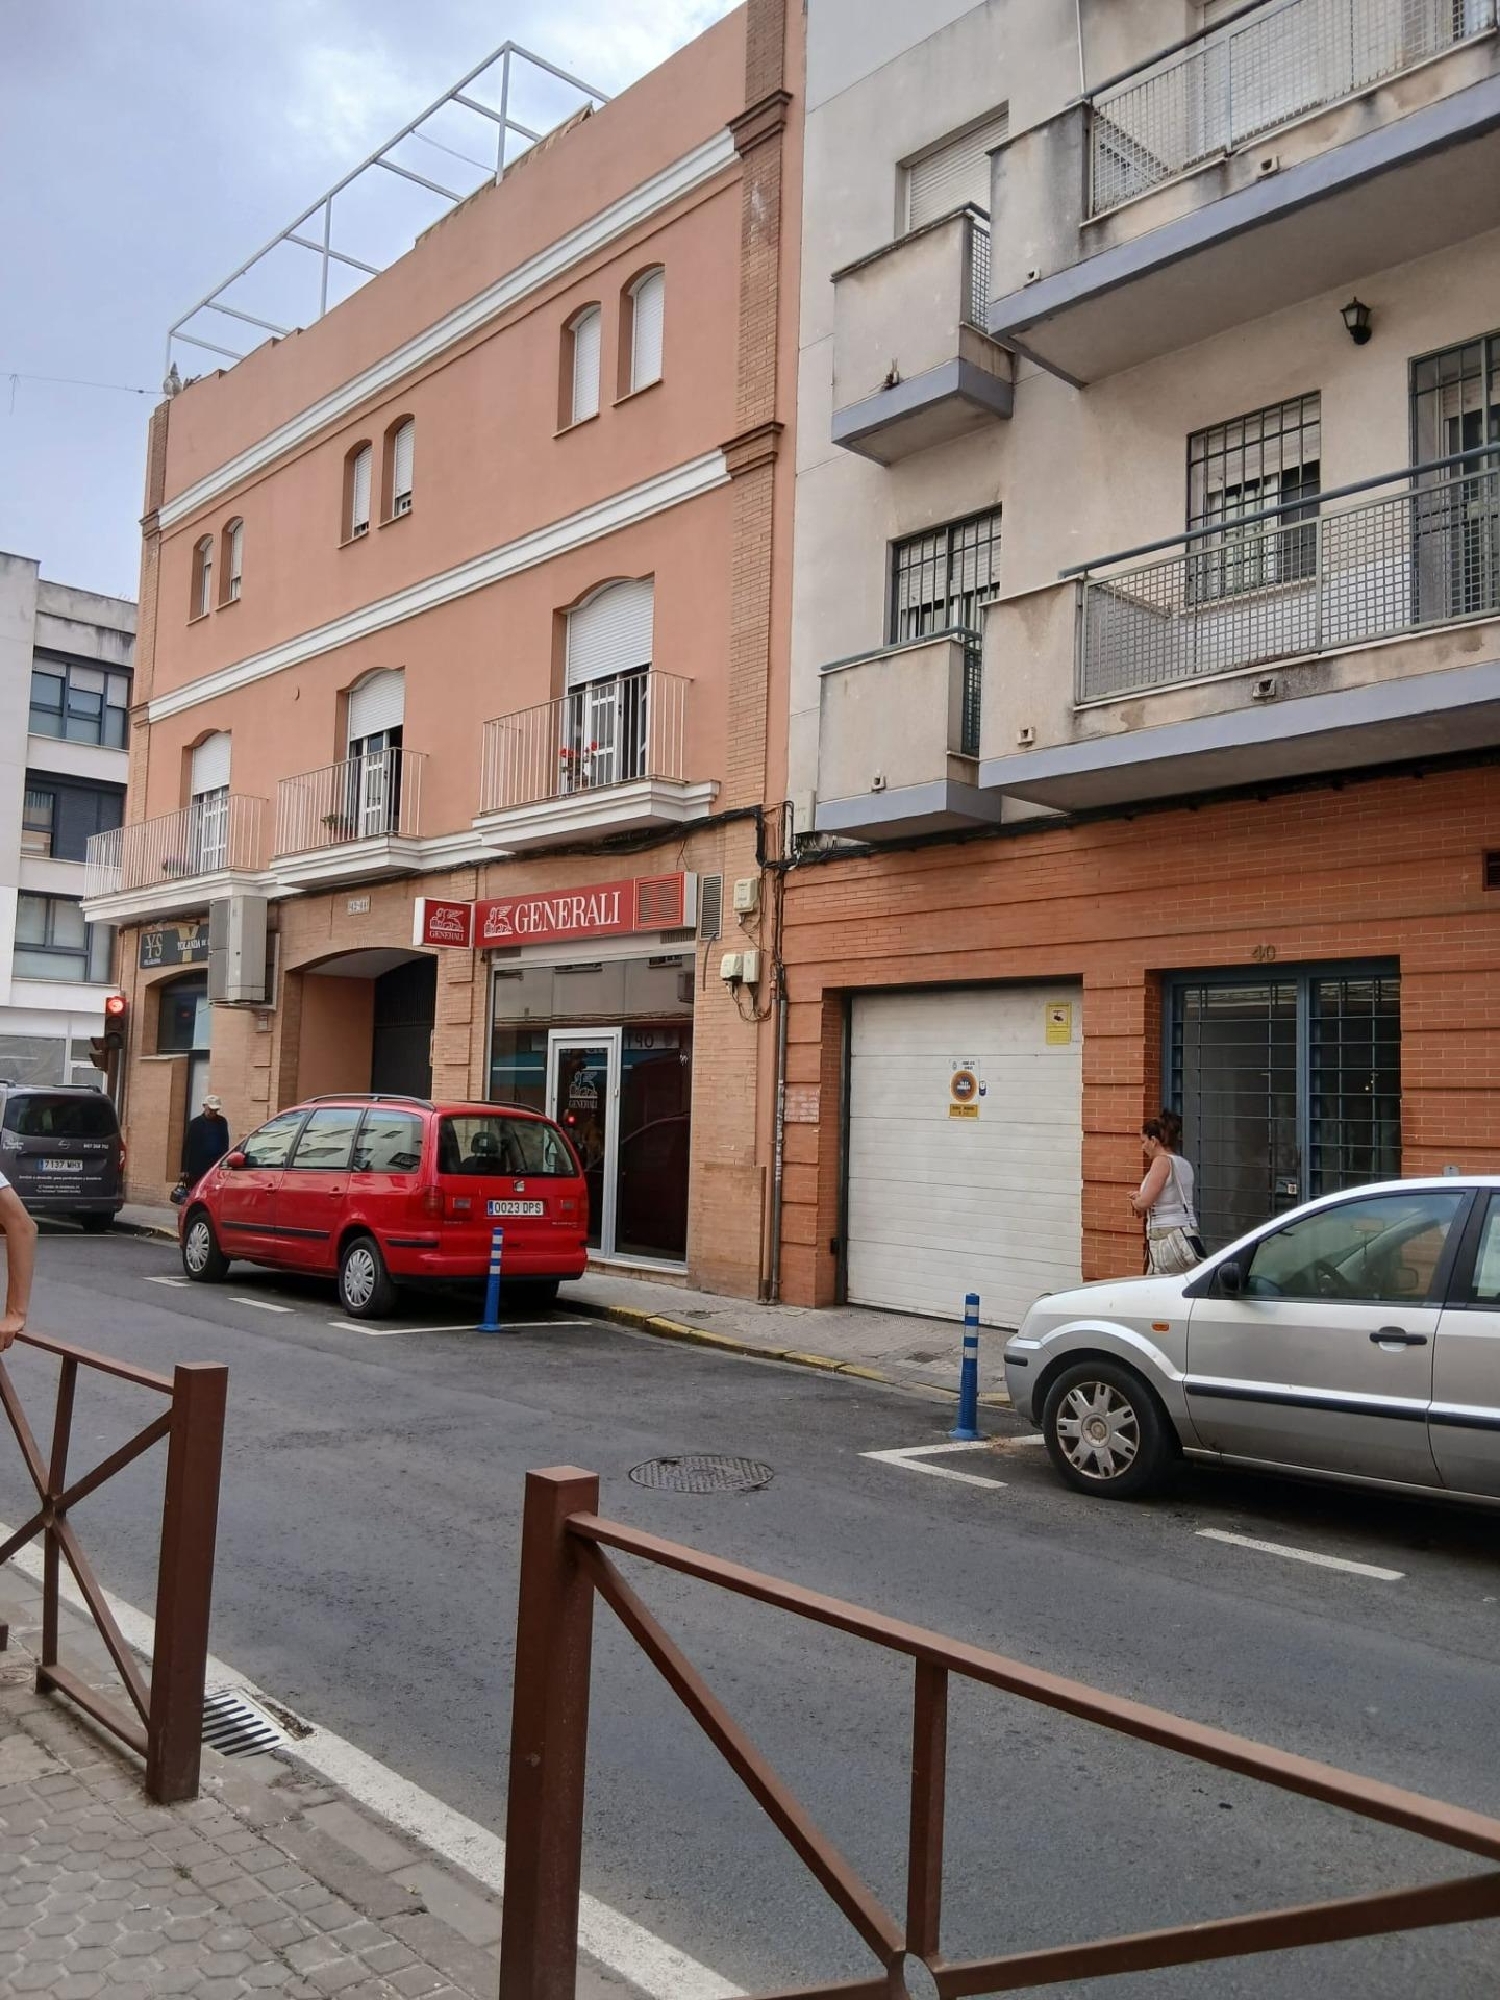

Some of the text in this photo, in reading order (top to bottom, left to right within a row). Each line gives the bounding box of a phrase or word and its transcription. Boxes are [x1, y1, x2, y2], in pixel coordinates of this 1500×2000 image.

[515, 891, 621, 934] GENERALI
[429, 930, 465, 942] GENERALI
[1252, 945, 1276, 961] 40
[568, 1098, 598, 1109] GENERALI
[494, 1201, 542, 1214] 0023 DPS
